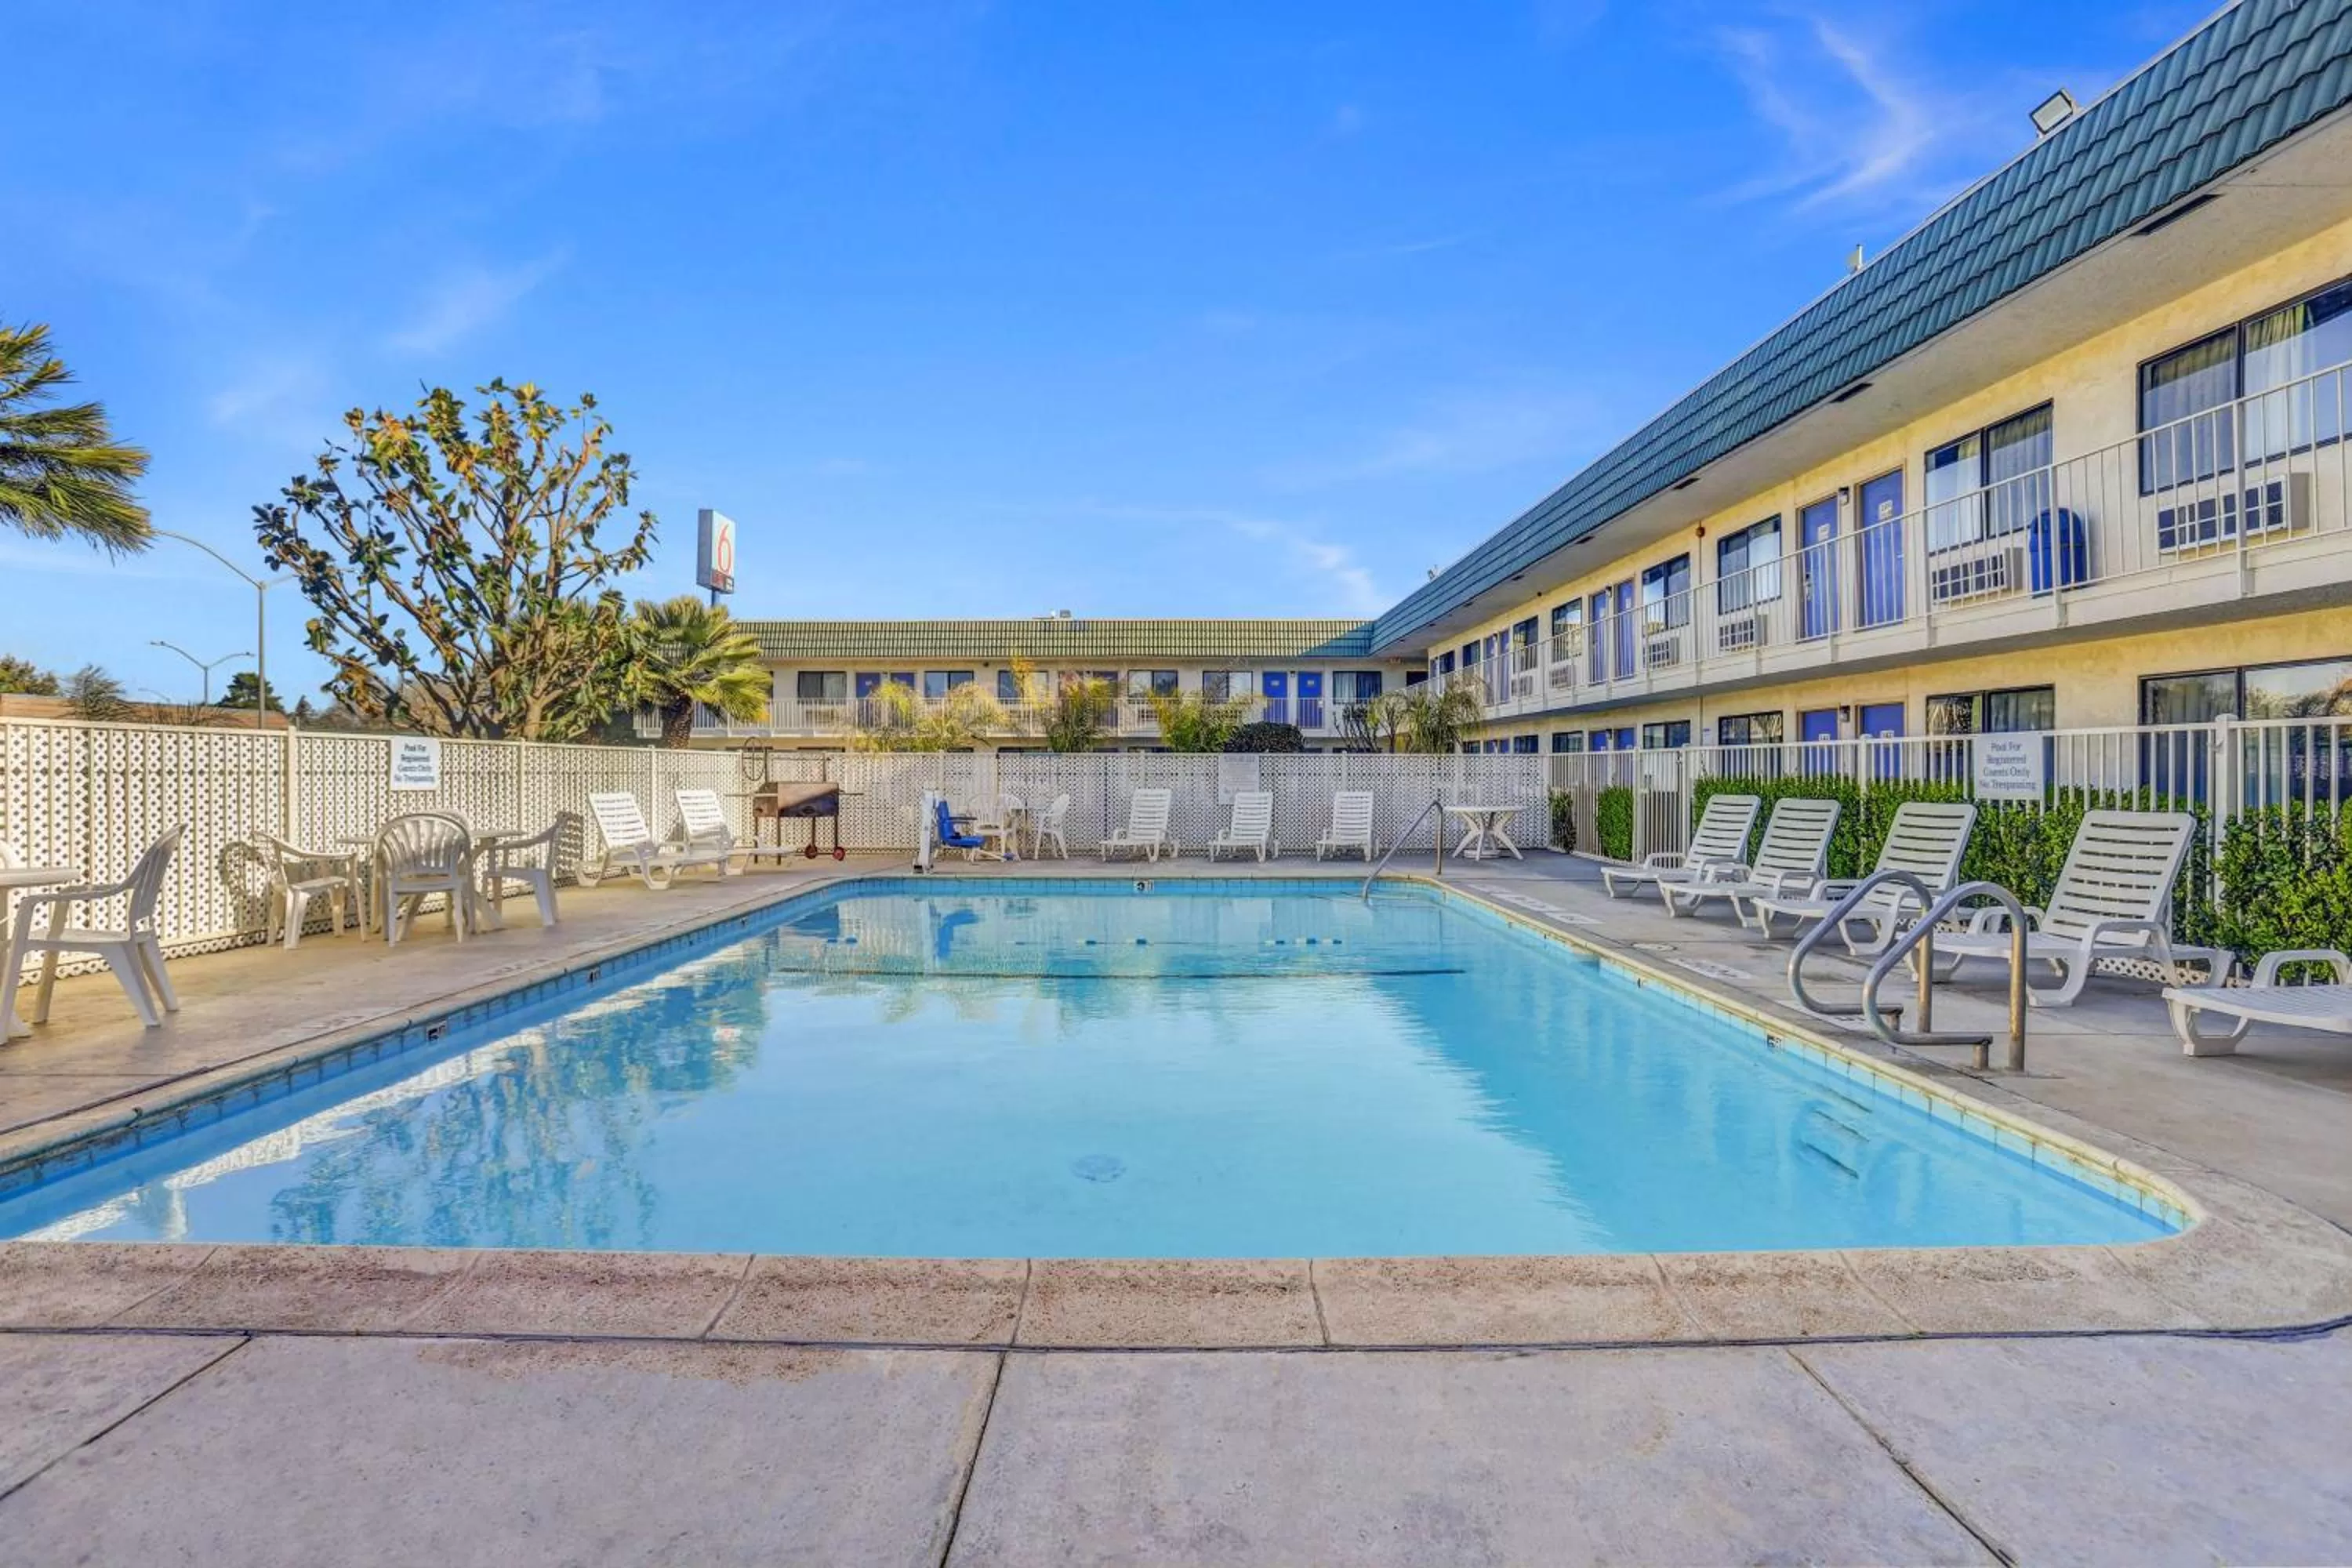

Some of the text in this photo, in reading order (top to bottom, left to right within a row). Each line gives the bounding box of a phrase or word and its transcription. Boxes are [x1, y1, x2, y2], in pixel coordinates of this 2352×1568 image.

[717, 522, 732, 573] 6
[1989, 741, 2022, 752] Pool For
[1983, 765, 2031, 778] Guests Only
